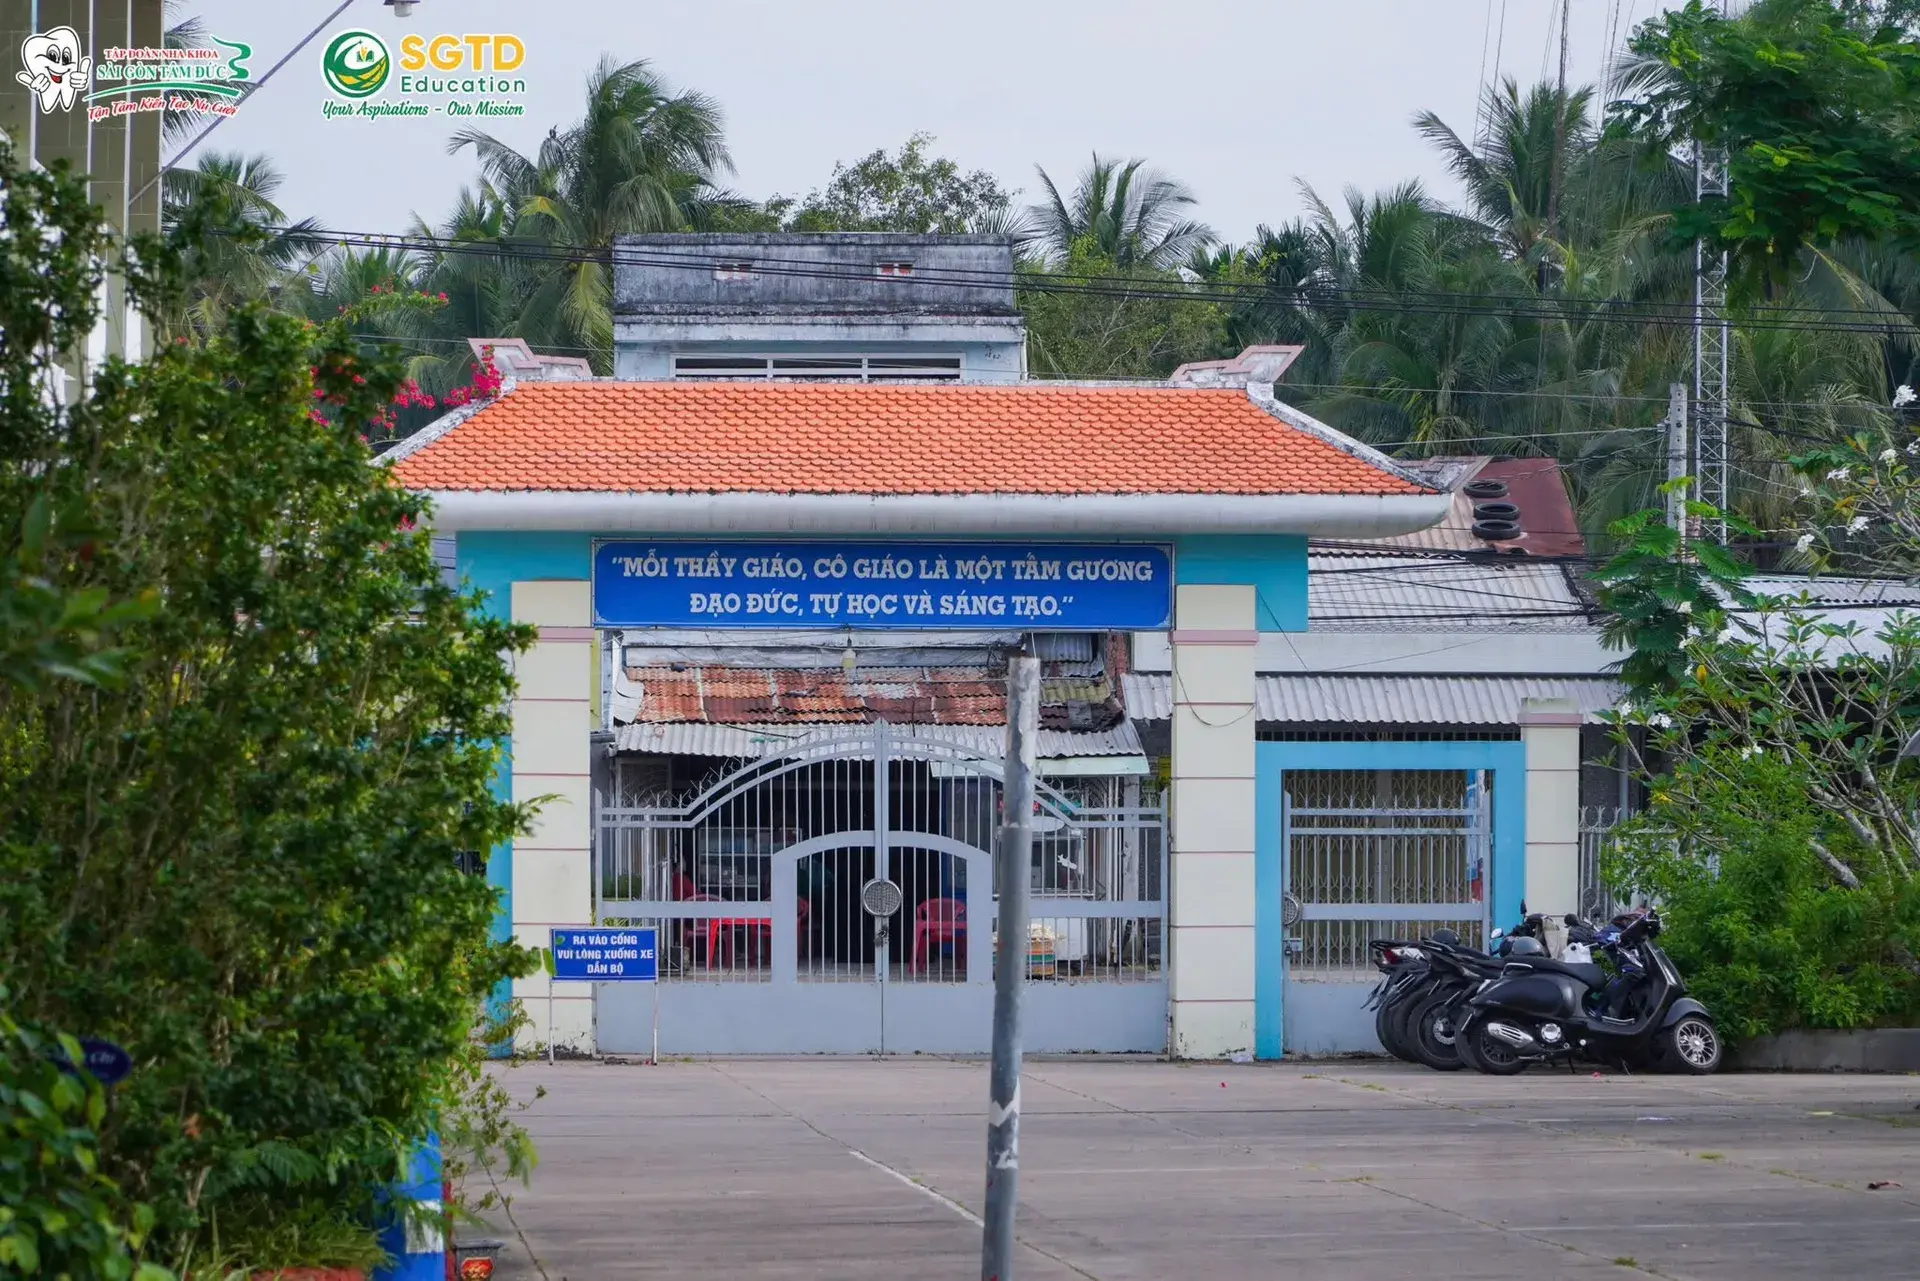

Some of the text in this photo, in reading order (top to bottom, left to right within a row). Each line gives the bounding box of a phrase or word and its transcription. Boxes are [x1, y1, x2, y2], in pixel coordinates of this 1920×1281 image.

[674, 550, 737, 577] THẦY
[742, 552, 807, 581] GIÁO,
[813, 553, 848, 578] CÔ
[853, 553, 913, 579] GIÁO
[919, 553, 950, 579] LÀ
[955, 555, 1006, 584] MỘT
[1012, 552, 1061, 580] TẤM
[1066, 558, 1153, 581] GƯƠNG
[690, 592, 741, 617] ĐẠO
[746, 588, 804, 616] ĐỨC,
[810, 592, 843, 618] TỰ
[847, 593, 898, 619] HỌC
[903, 589, 934, 615] VÀ
[940, 589, 1005, 615] SÁNG
[572, 935, 587, 945] RA
[557, 949, 573, 959] VUI
[576, 947, 601, 959] LÒNG
[640, 949, 654, 959] XE
